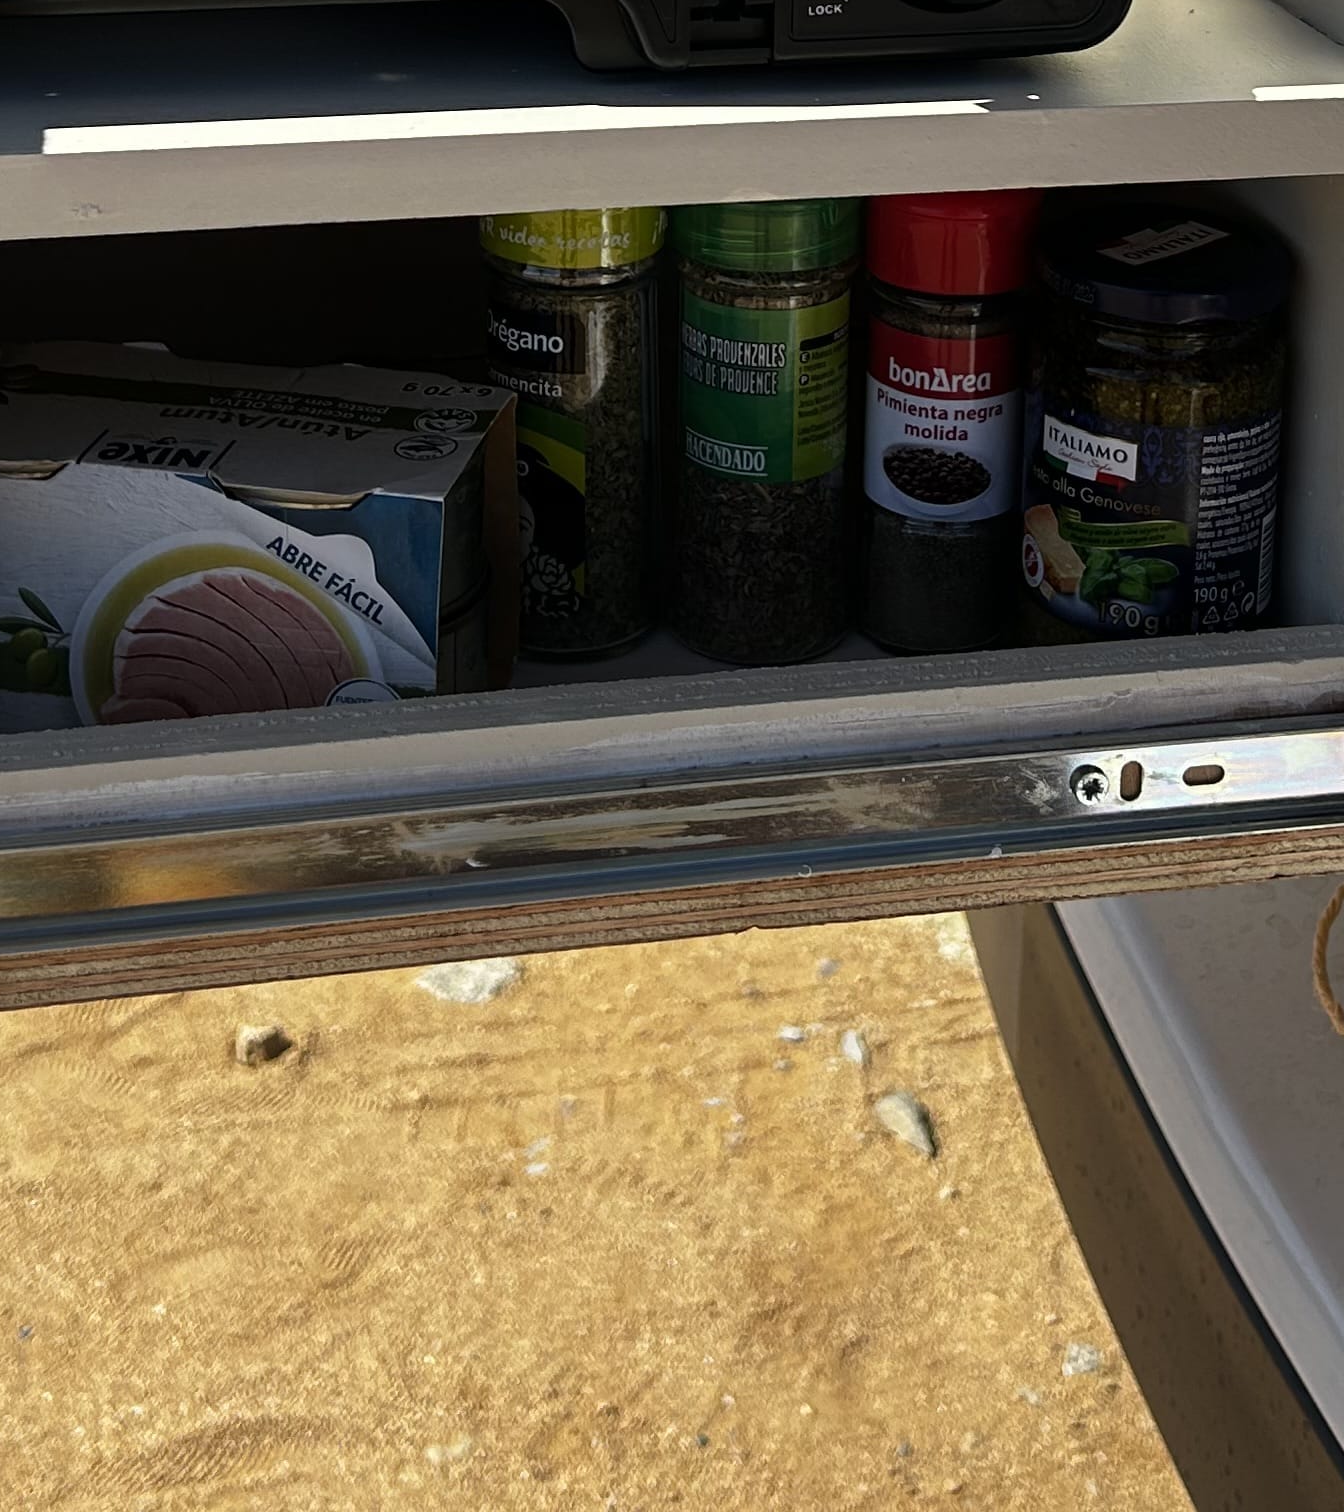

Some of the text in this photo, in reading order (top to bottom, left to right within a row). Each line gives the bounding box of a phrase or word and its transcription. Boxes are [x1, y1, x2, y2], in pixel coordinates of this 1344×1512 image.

[807, 3, 844, 17] LOCK
[888, 355, 992, 393] bonArea
[876, 387, 1004, 424] Pimienta negra
[904, 422, 969, 441] molida
[1048, 424, 1129, 464] ITALIAMO
[685, 431, 767, 472] HACENDADO
[1052, 477, 1076, 498] alla
[1079, 487, 1161, 517] Genovese
[266, 536, 385, 626] ABRE FÁCIL
